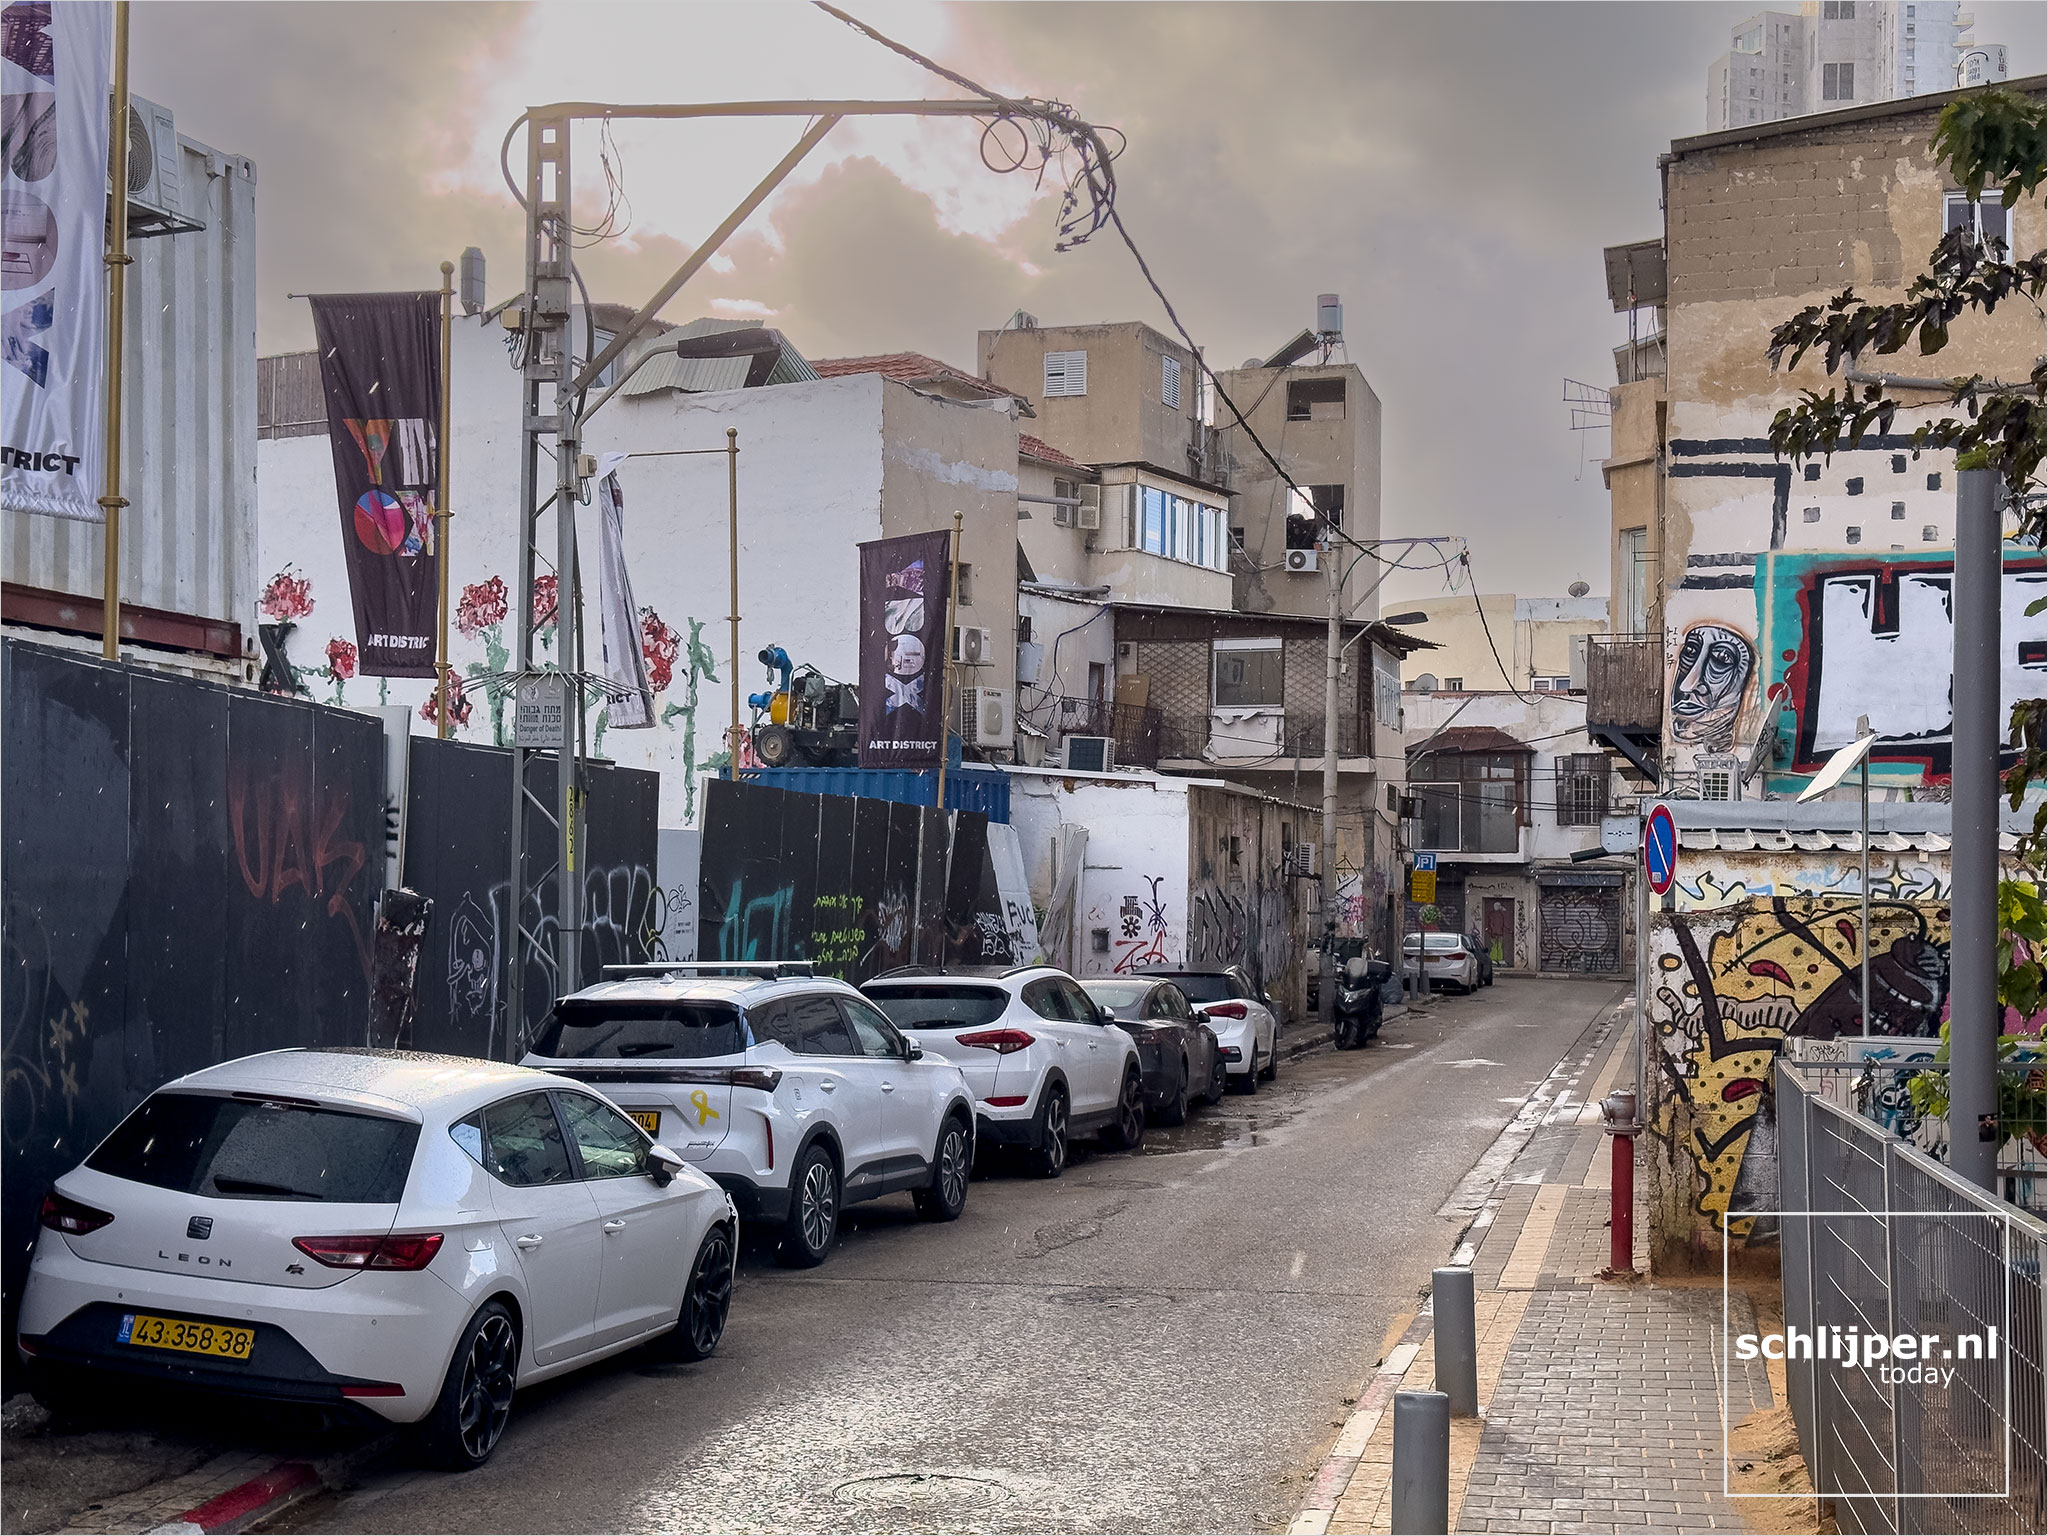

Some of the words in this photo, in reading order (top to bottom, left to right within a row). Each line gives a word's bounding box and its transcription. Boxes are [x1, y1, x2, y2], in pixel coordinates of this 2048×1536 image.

[368, 633, 388, 647] ART
[519, 724, 538, 734] Danger
[538, 724, 545, 732] of
[869, 740, 890, 749] ART
[892, 741, 938, 750] DISTRICT
[158, 1250, 232, 1267] LEON
